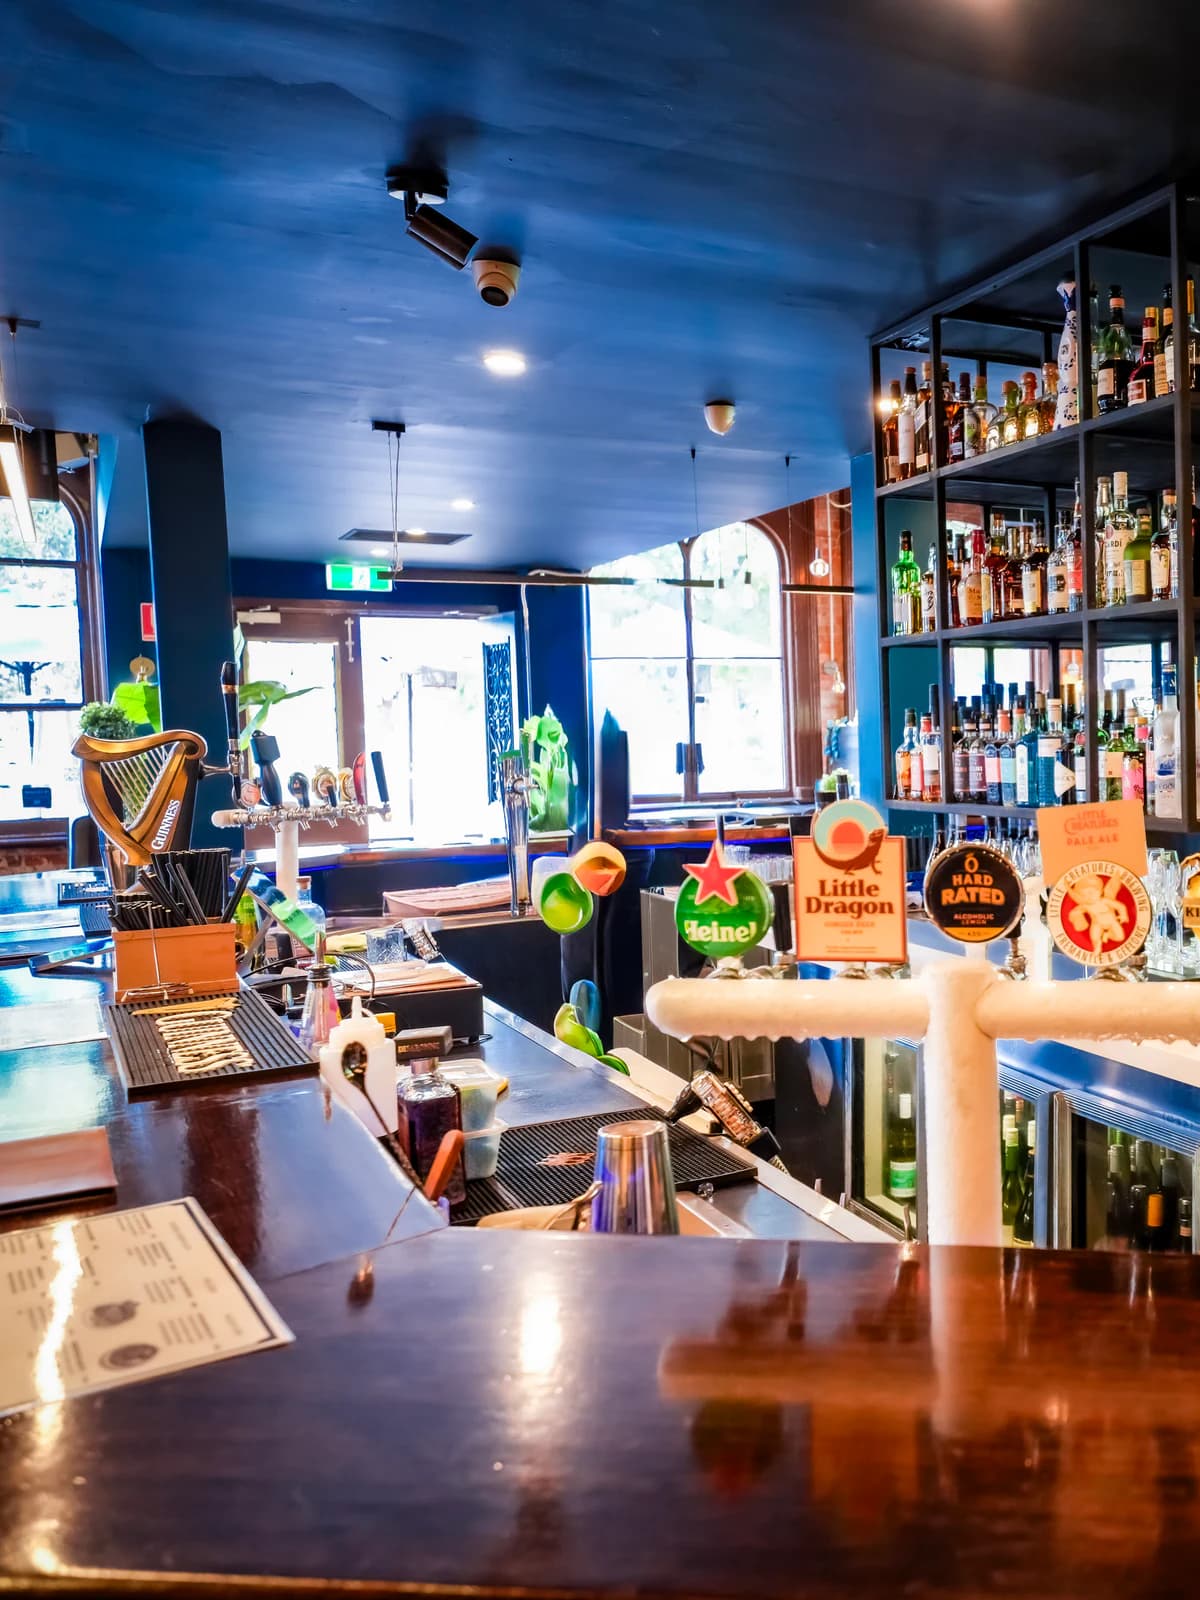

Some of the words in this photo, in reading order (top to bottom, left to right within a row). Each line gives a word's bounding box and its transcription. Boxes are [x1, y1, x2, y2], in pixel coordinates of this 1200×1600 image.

[151, 799, 181, 850] GUINNESS
[818, 878, 881, 897] Little
[952, 874, 993, 887] HARD
[1049, 888, 1065, 918] LITTLE
[1063, 862, 1115, 886] CREATURES
[941, 886, 1006, 907] RATED
[804, 896, 896, 920] Dragon
